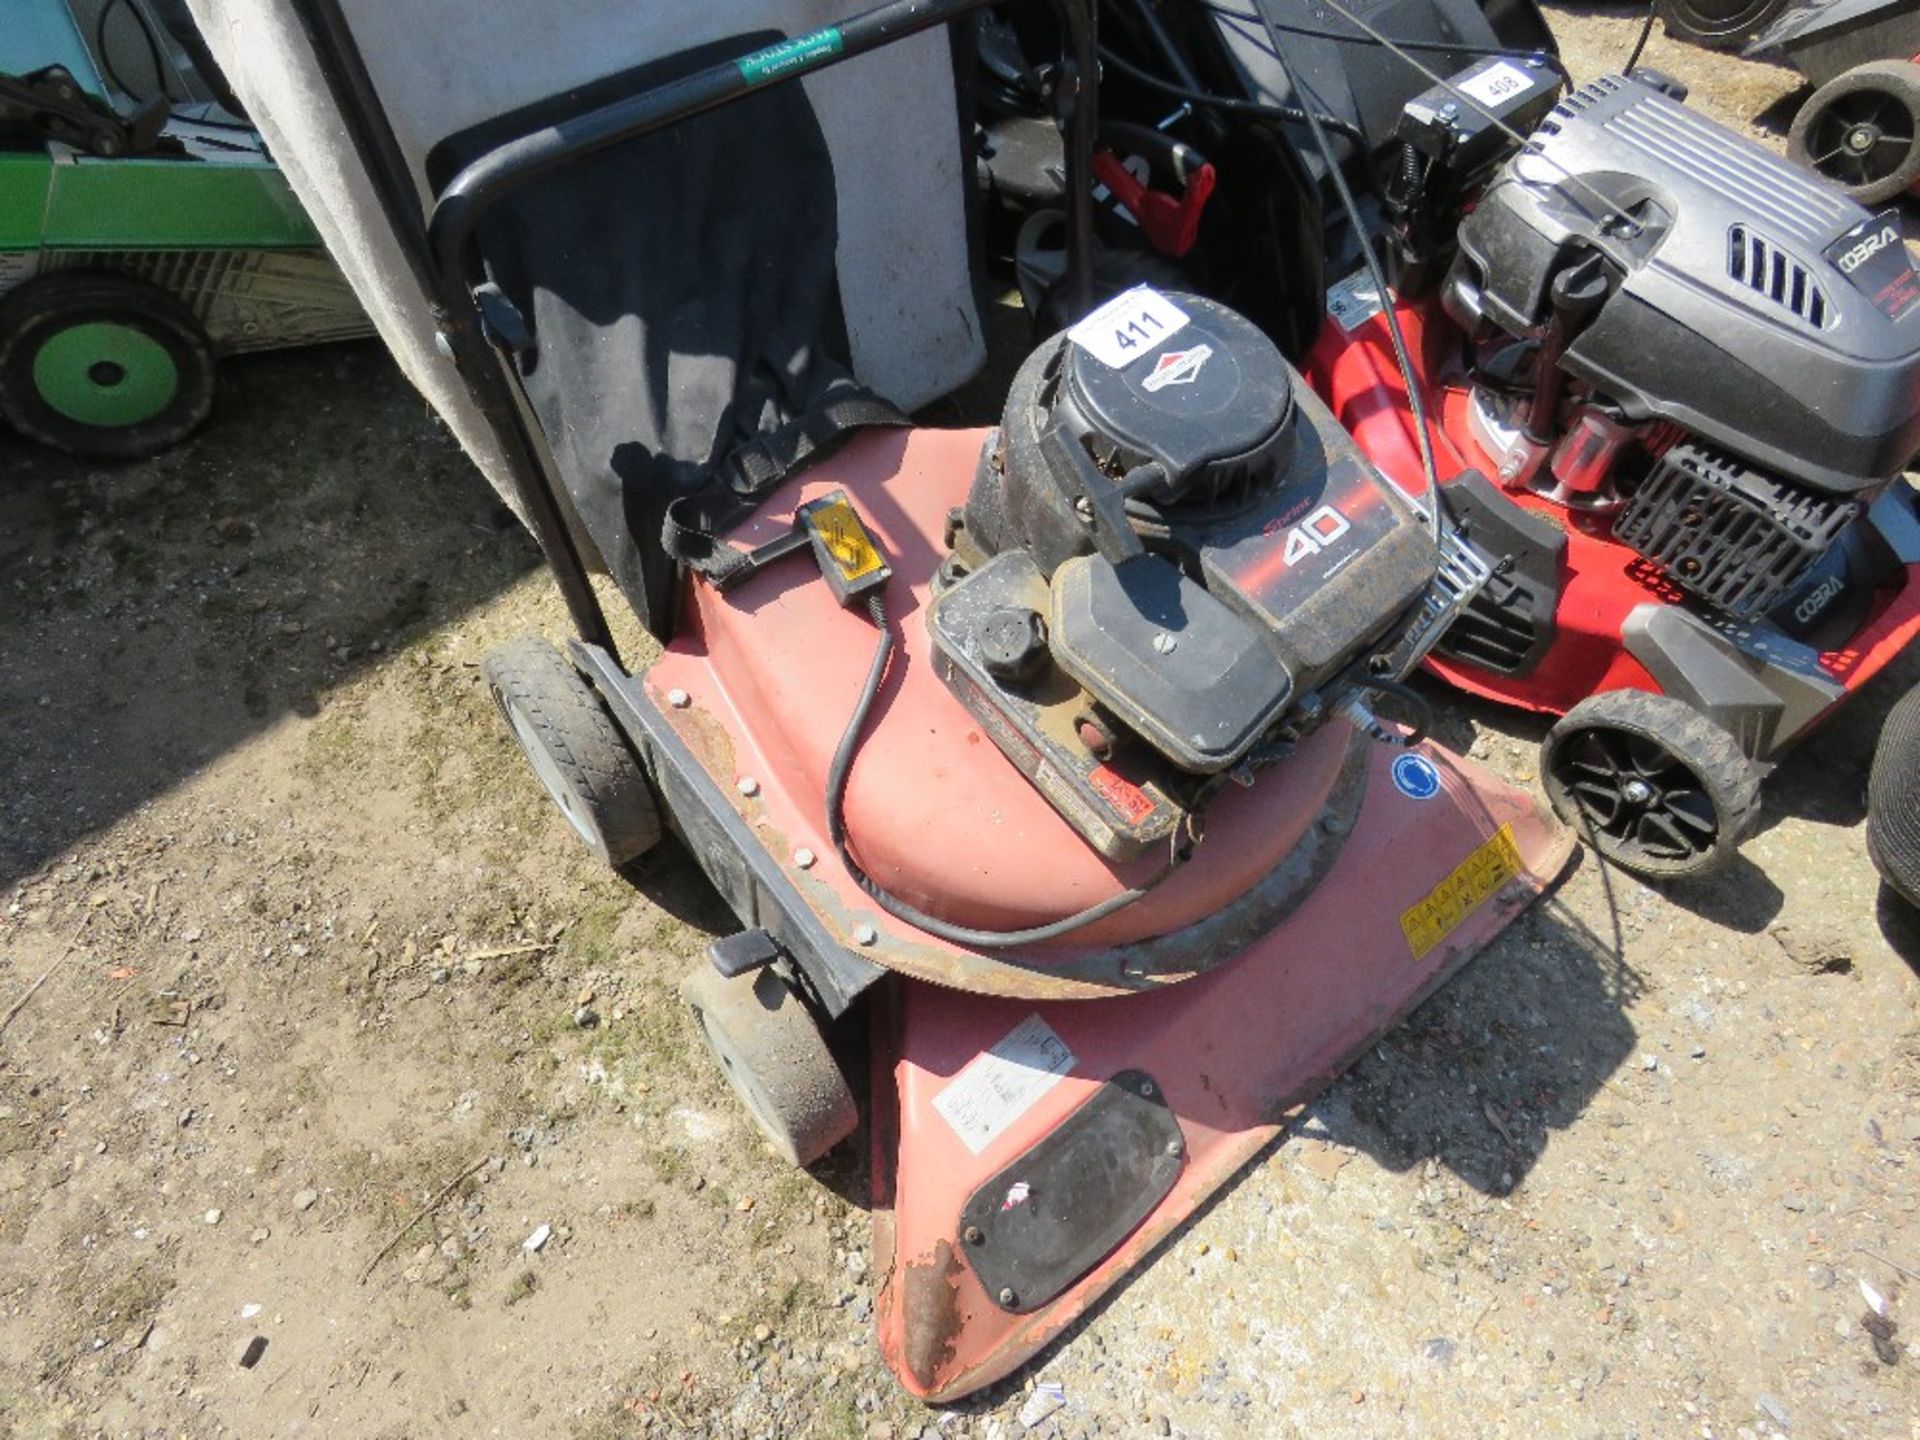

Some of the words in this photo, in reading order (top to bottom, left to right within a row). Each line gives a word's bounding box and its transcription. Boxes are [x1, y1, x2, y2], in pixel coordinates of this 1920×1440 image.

[1488, 76, 1519, 95] 408
[1838, 226, 1899, 273] COBRA
[1115, 312, 1164, 350] 411
[1282, 505, 1350, 567] 40
[1795, 575, 1844, 623] COBRA
